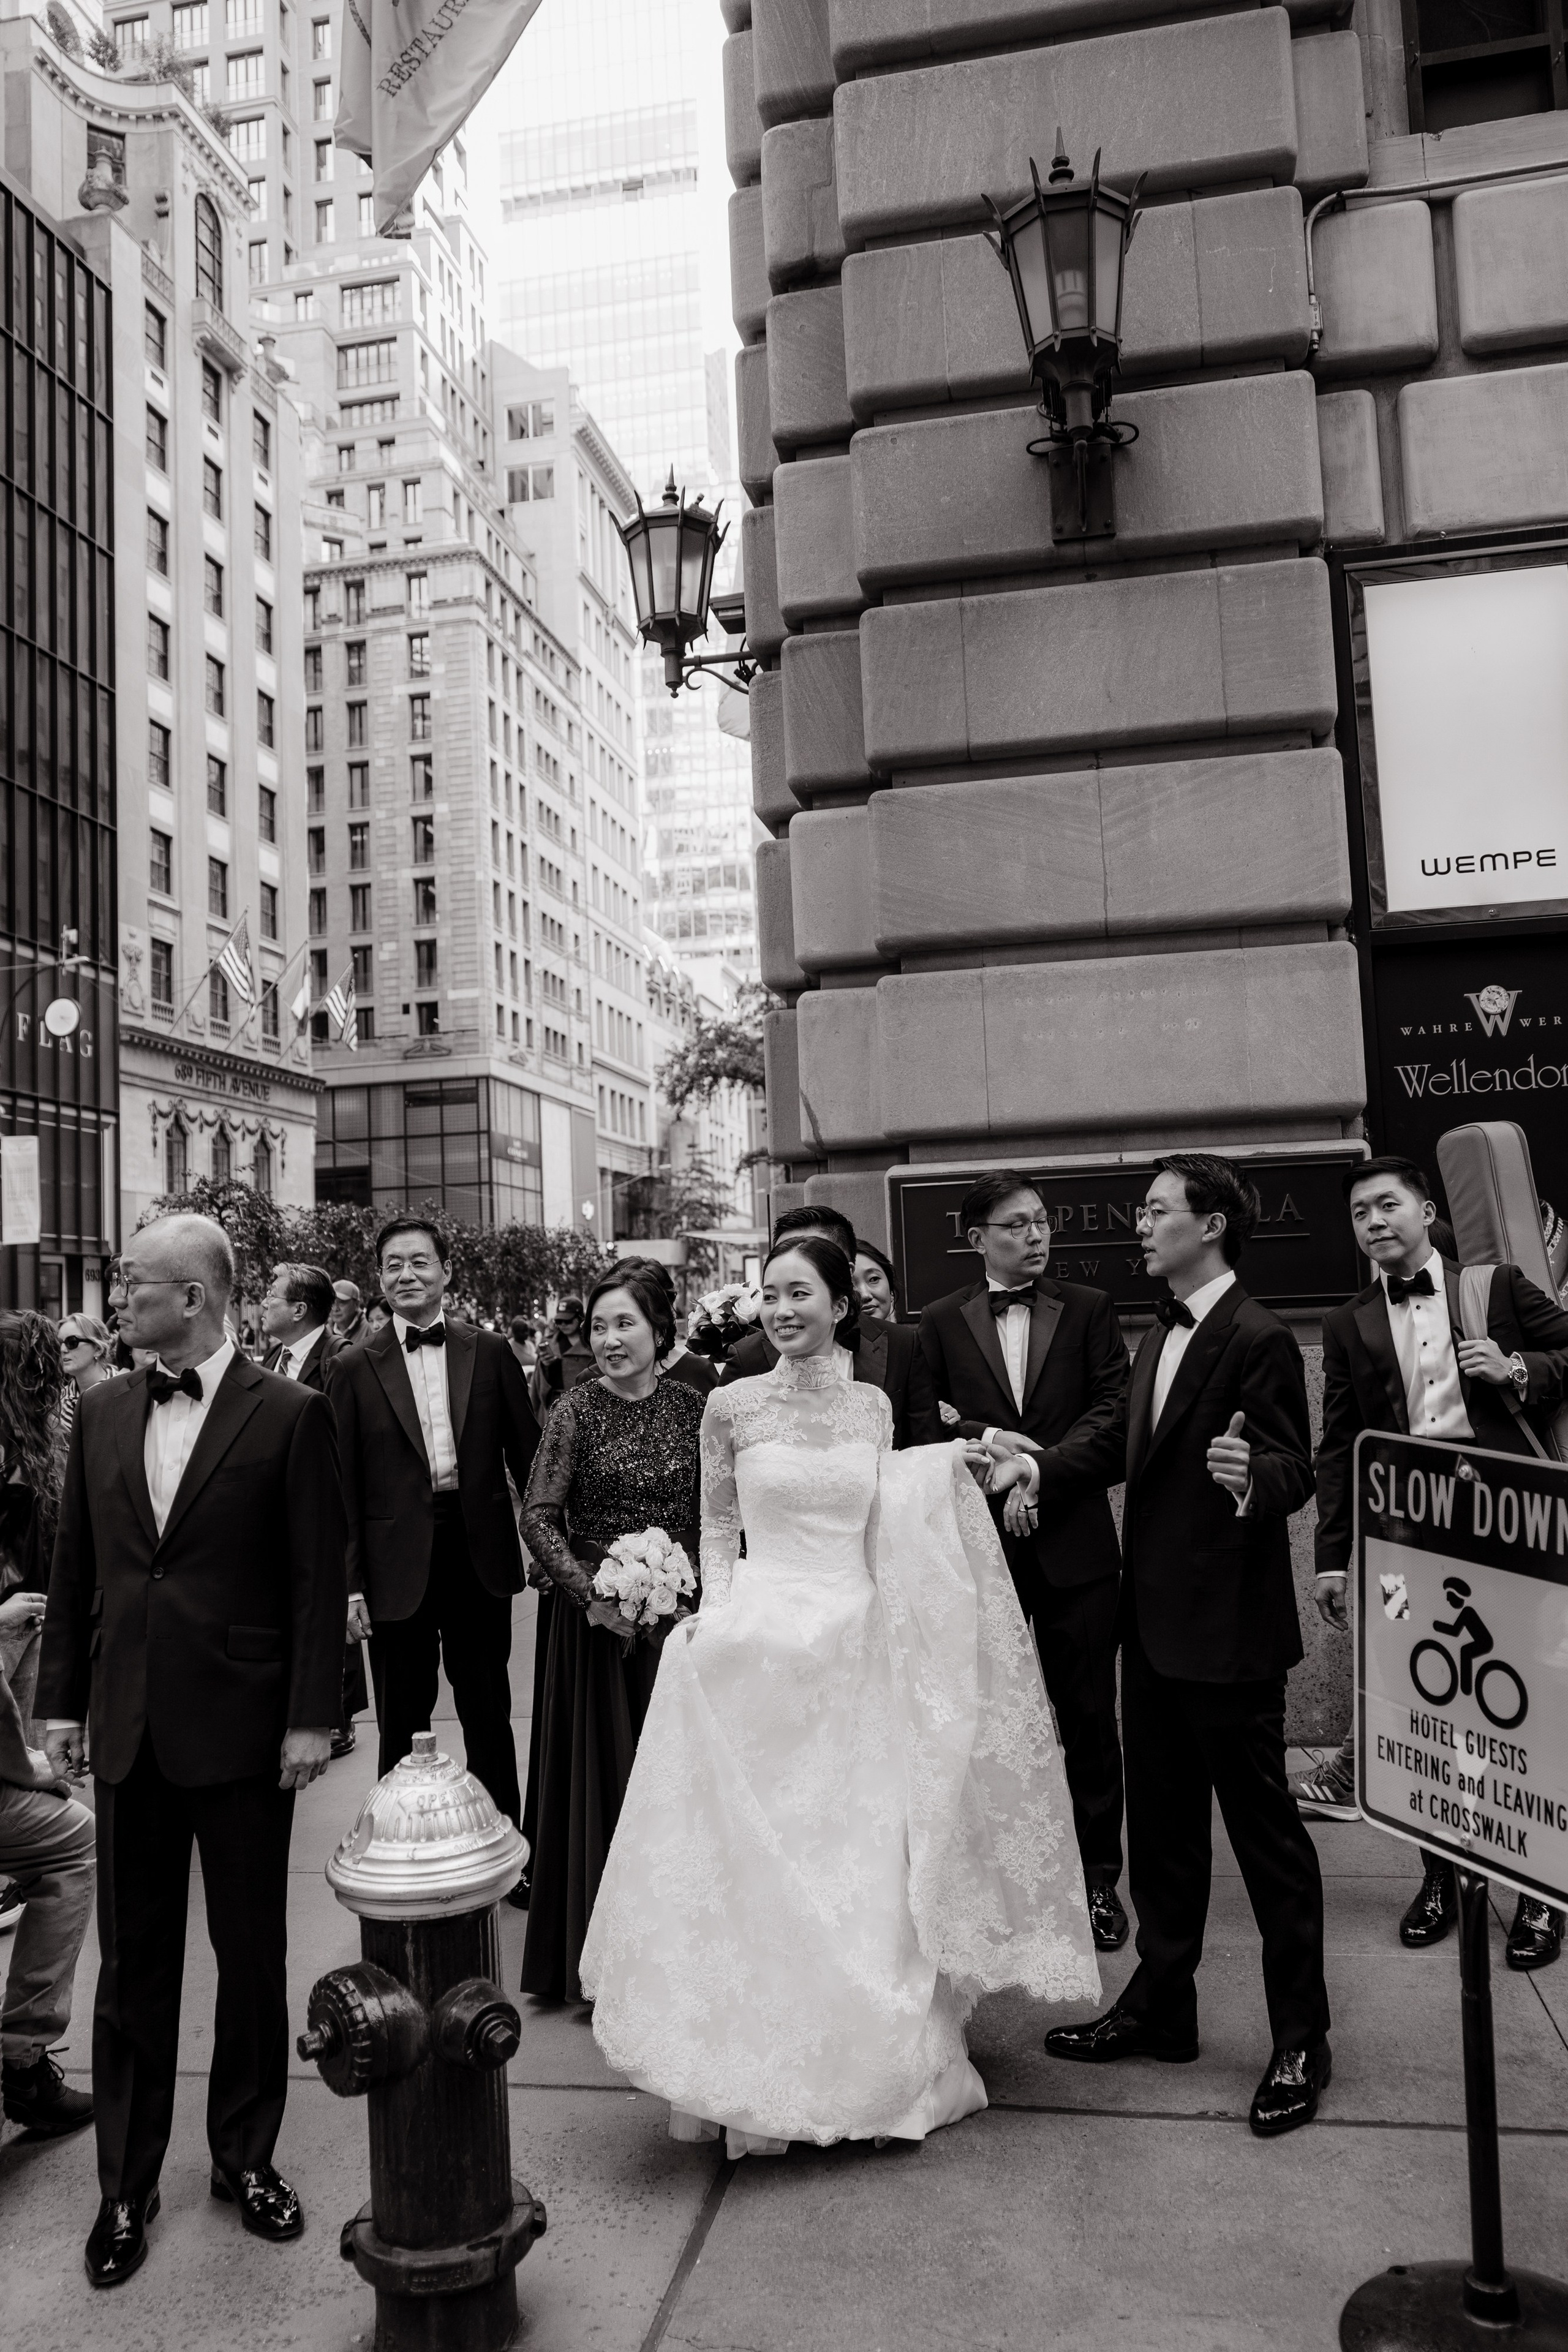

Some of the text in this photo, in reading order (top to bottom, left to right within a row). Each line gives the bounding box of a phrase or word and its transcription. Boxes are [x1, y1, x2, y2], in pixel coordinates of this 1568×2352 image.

[377, 0, 469, 98] RESTAUR
[1421, 849, 1556, 876] WEMPE
[1401, 1022, 1472, 1036] WAHRE
[1519, 1016, 1562, 1027] WER
[195, 1067, 226, 1091] FIFTH
[229, 1076, 270, 1102] AVENUE
[85, 1268, 100, 1282] 693
[1368, 1461, 1456, 1530] SLOW
[1410, 1709, 1528, 1775] HOTEL GUESTS
[417, 1788, 462, 1810] OPEN
[1378, 1735, 1567, 1832] ENTERING and LEAVING
[1409, 1789, 1528, 1858] at CROSSWALK
